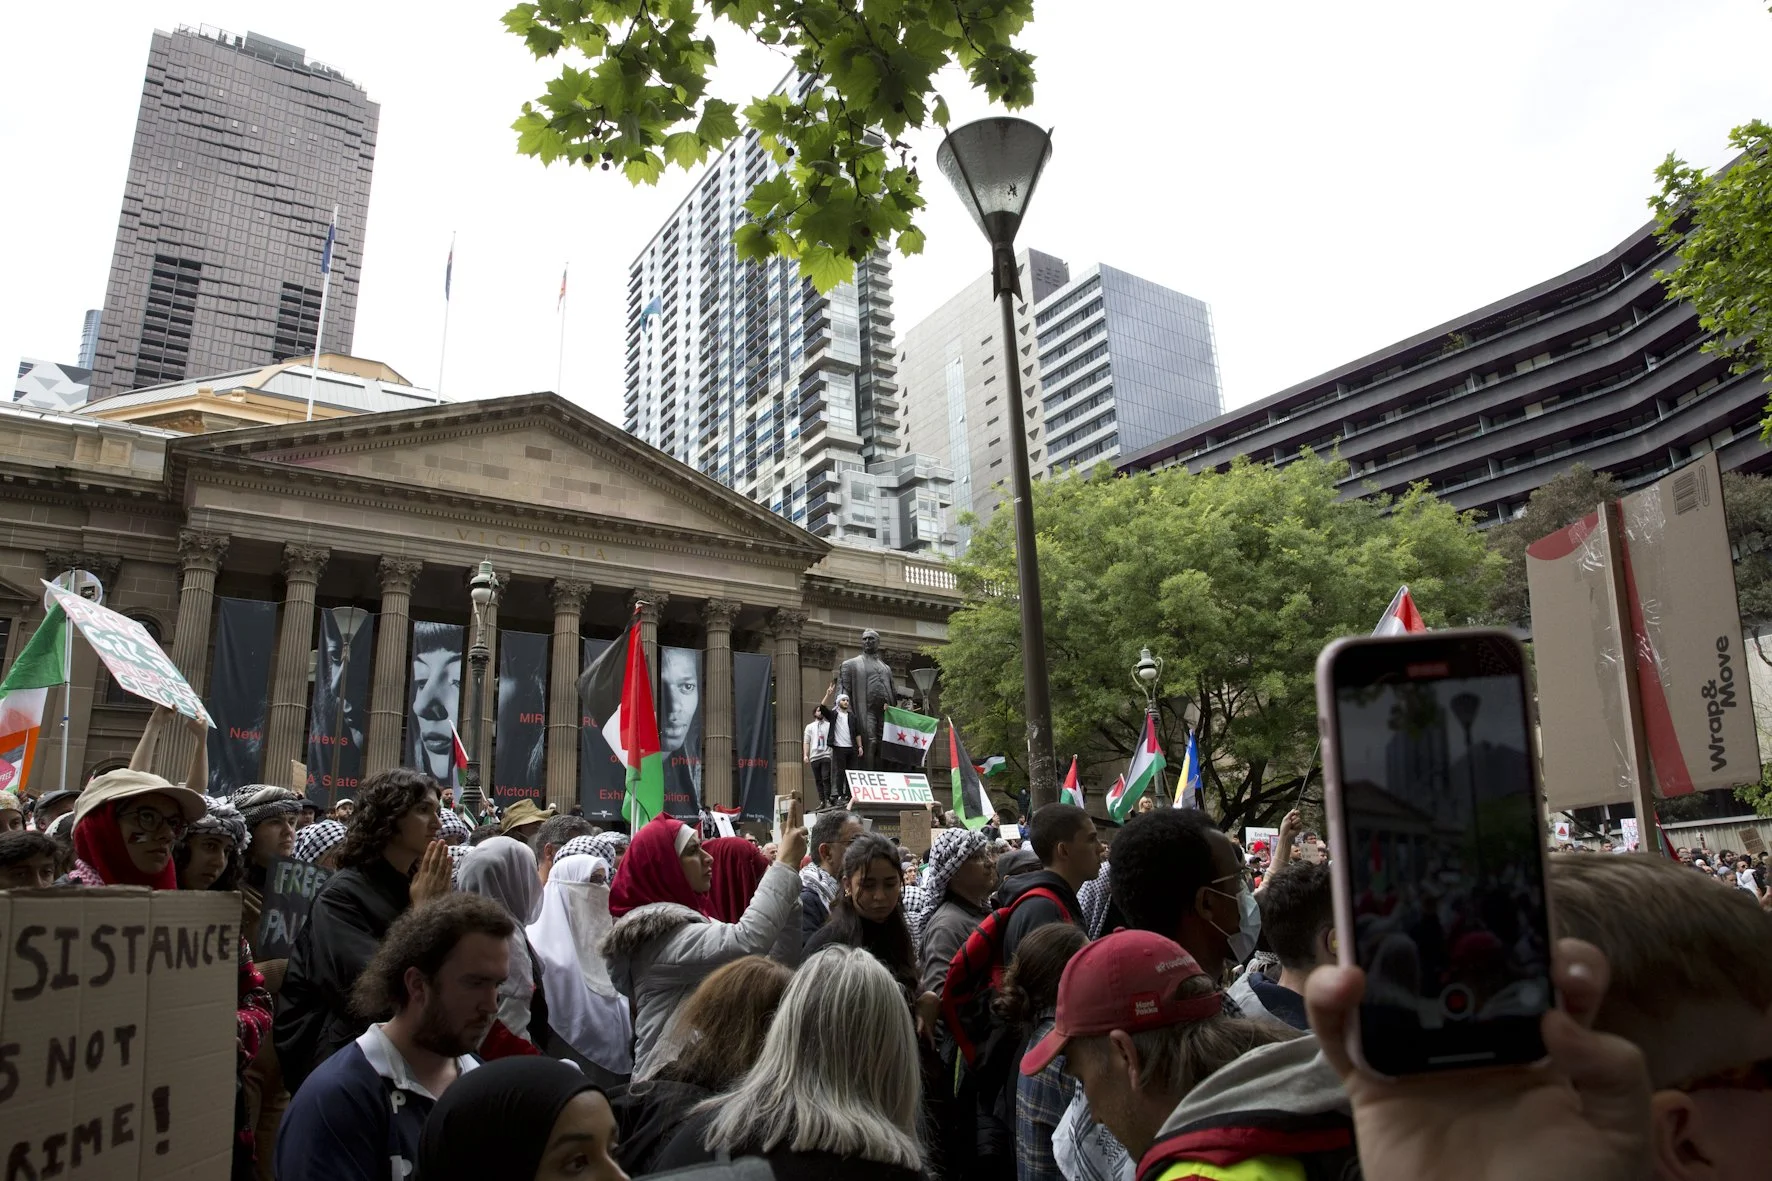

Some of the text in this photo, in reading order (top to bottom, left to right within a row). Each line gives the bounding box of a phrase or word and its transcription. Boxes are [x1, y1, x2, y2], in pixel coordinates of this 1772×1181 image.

[456, 528, 607, 561] VICTORIA
[1716, 635, 1737, 708] Move
[230, 727, 261, 740] New
[322, 775, 358, 788] Sate
[496, 785, 540, 798] Victoria
[848, 772, 887, 787] FREE
[853, 786, 932, 802] PALESTINE
[261, 908, 308, 946] PAL
[0, 924, 233, 1001] SISTANCE
[46, 1024, 137, 1088] NOT
